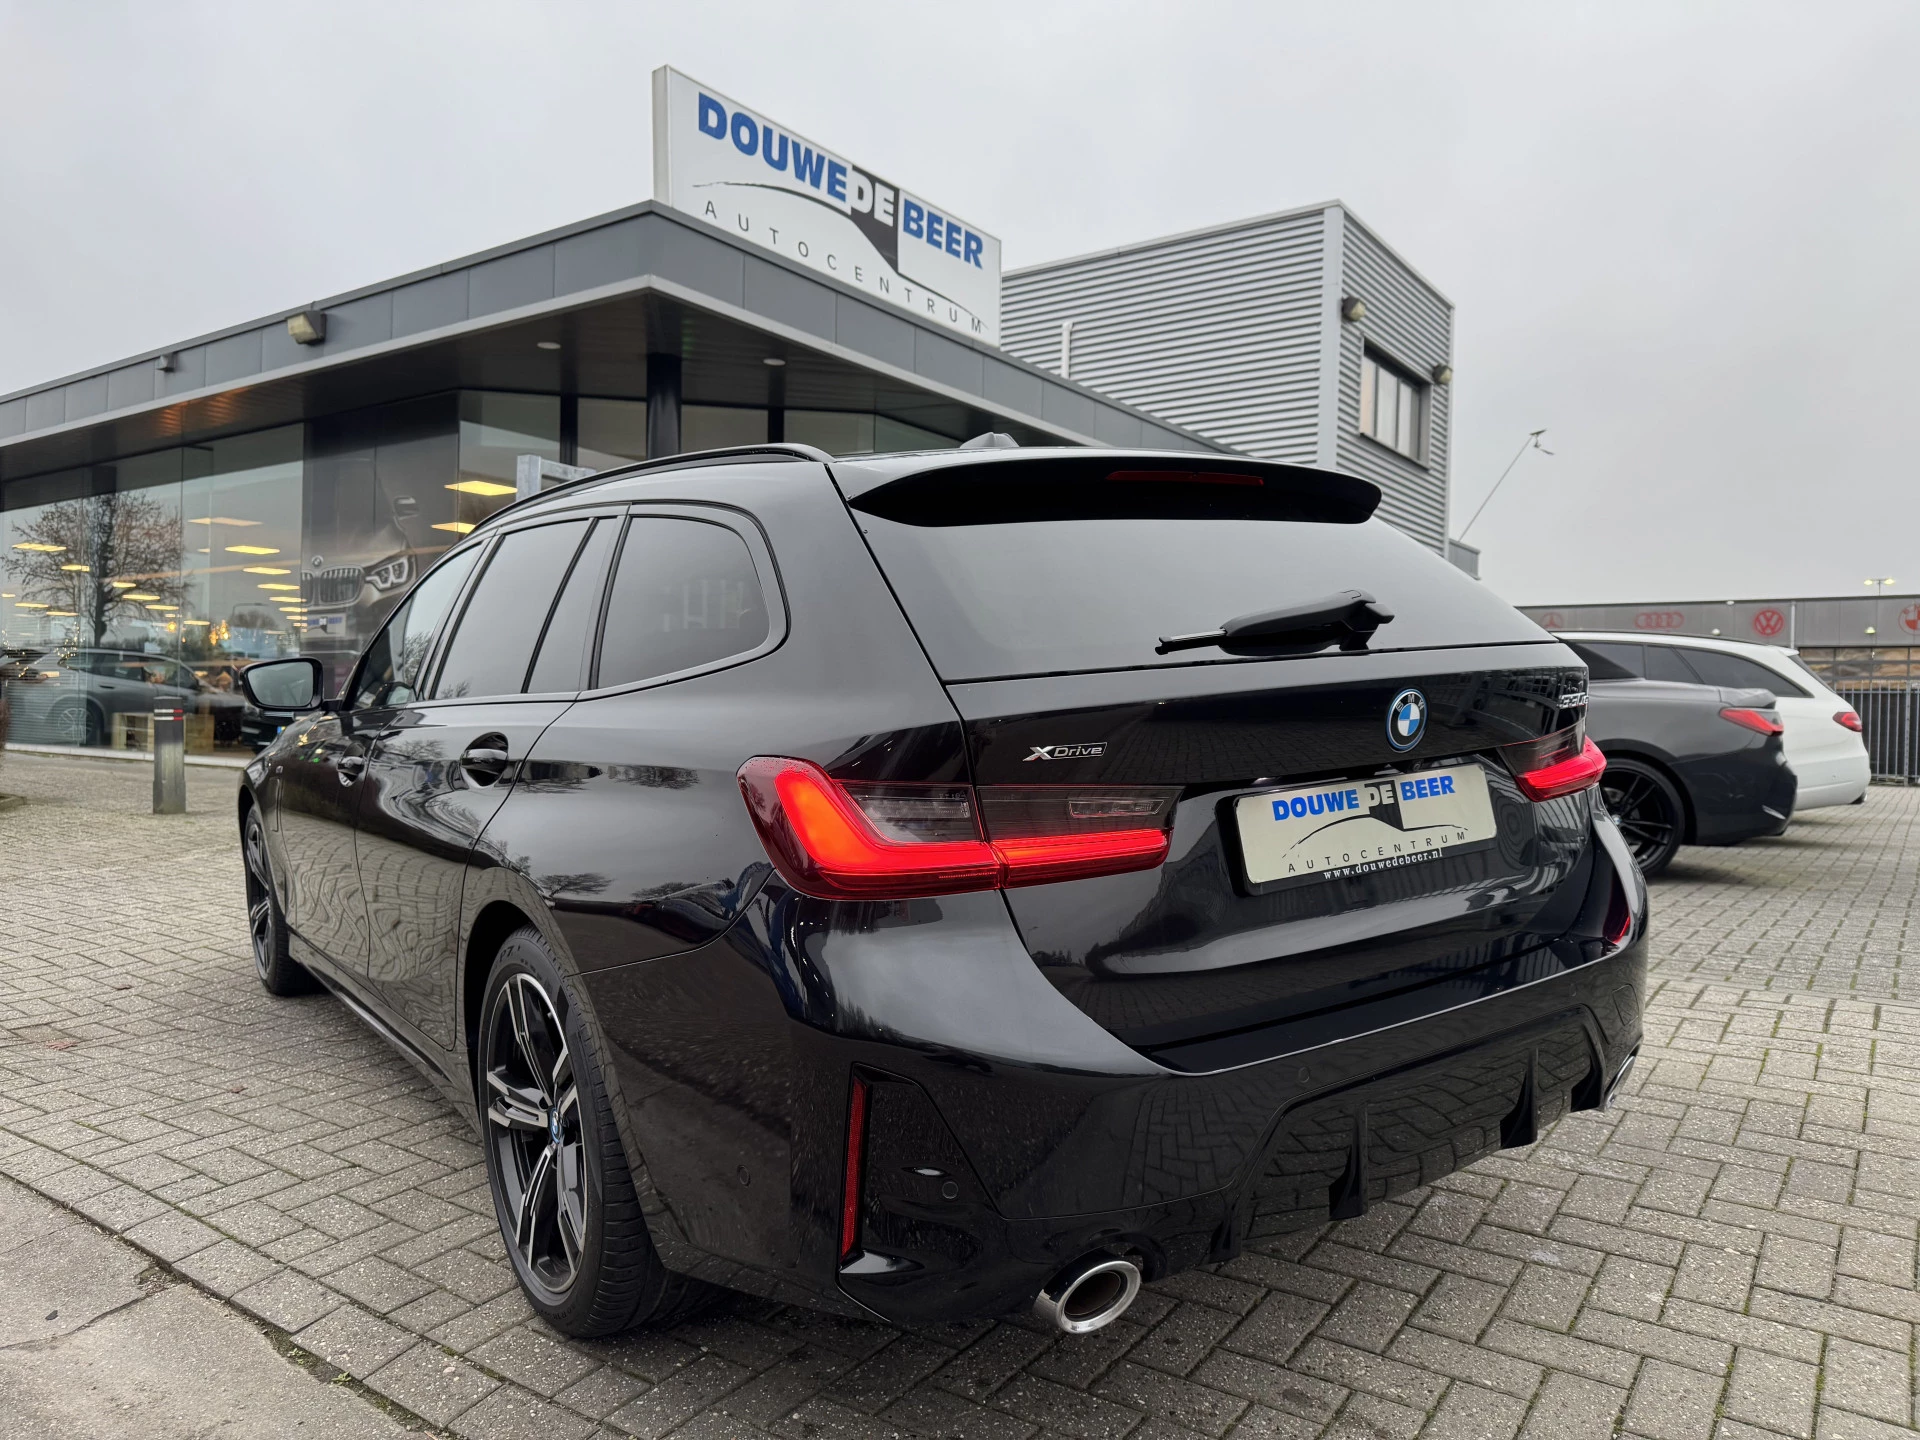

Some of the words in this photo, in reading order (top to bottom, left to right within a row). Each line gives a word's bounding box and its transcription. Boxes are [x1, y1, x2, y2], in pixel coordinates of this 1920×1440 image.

[698, 91, 847, 204] DOUWE
[850, 168, 895, 228] DE
[903, 198, 983, 270] BEER
[704, 200, 982, 333] AUTOCENTRUM
[1272, 789, 1360, 821] DOUWE
[1368, 784, 1395, 808] DE
[1400, 775, 1455, 801] BEER
[1288, 832, 1465, 873] AUTOCENTRUM
[1323, 849, 1443, 880] www.douwedebeer.nl
